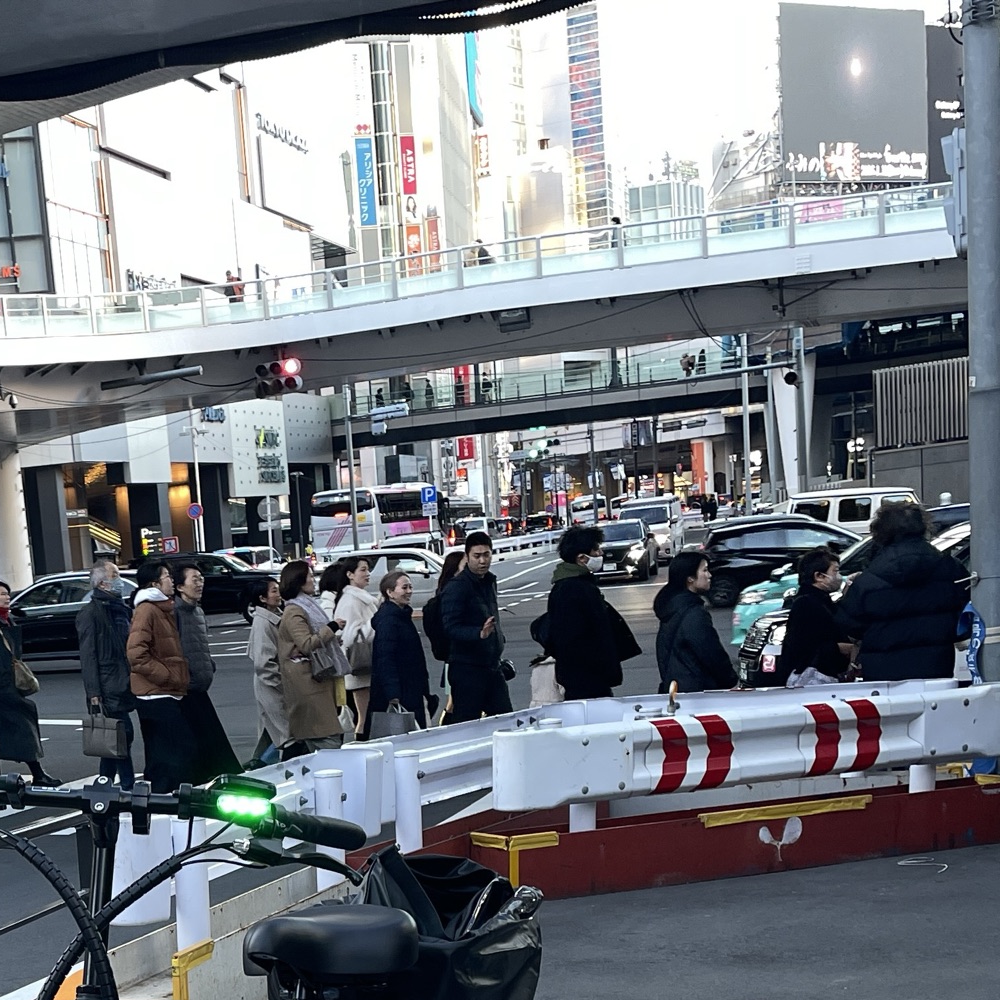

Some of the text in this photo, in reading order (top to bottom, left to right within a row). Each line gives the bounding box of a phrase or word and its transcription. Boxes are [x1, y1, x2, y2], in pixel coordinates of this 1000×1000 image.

[364, 153, 373, 186] アリシア
[406, 149, 415, 182] ASTRA
[359, 179, 368, 221] クリニック
[425, 488, 434, 502] P
